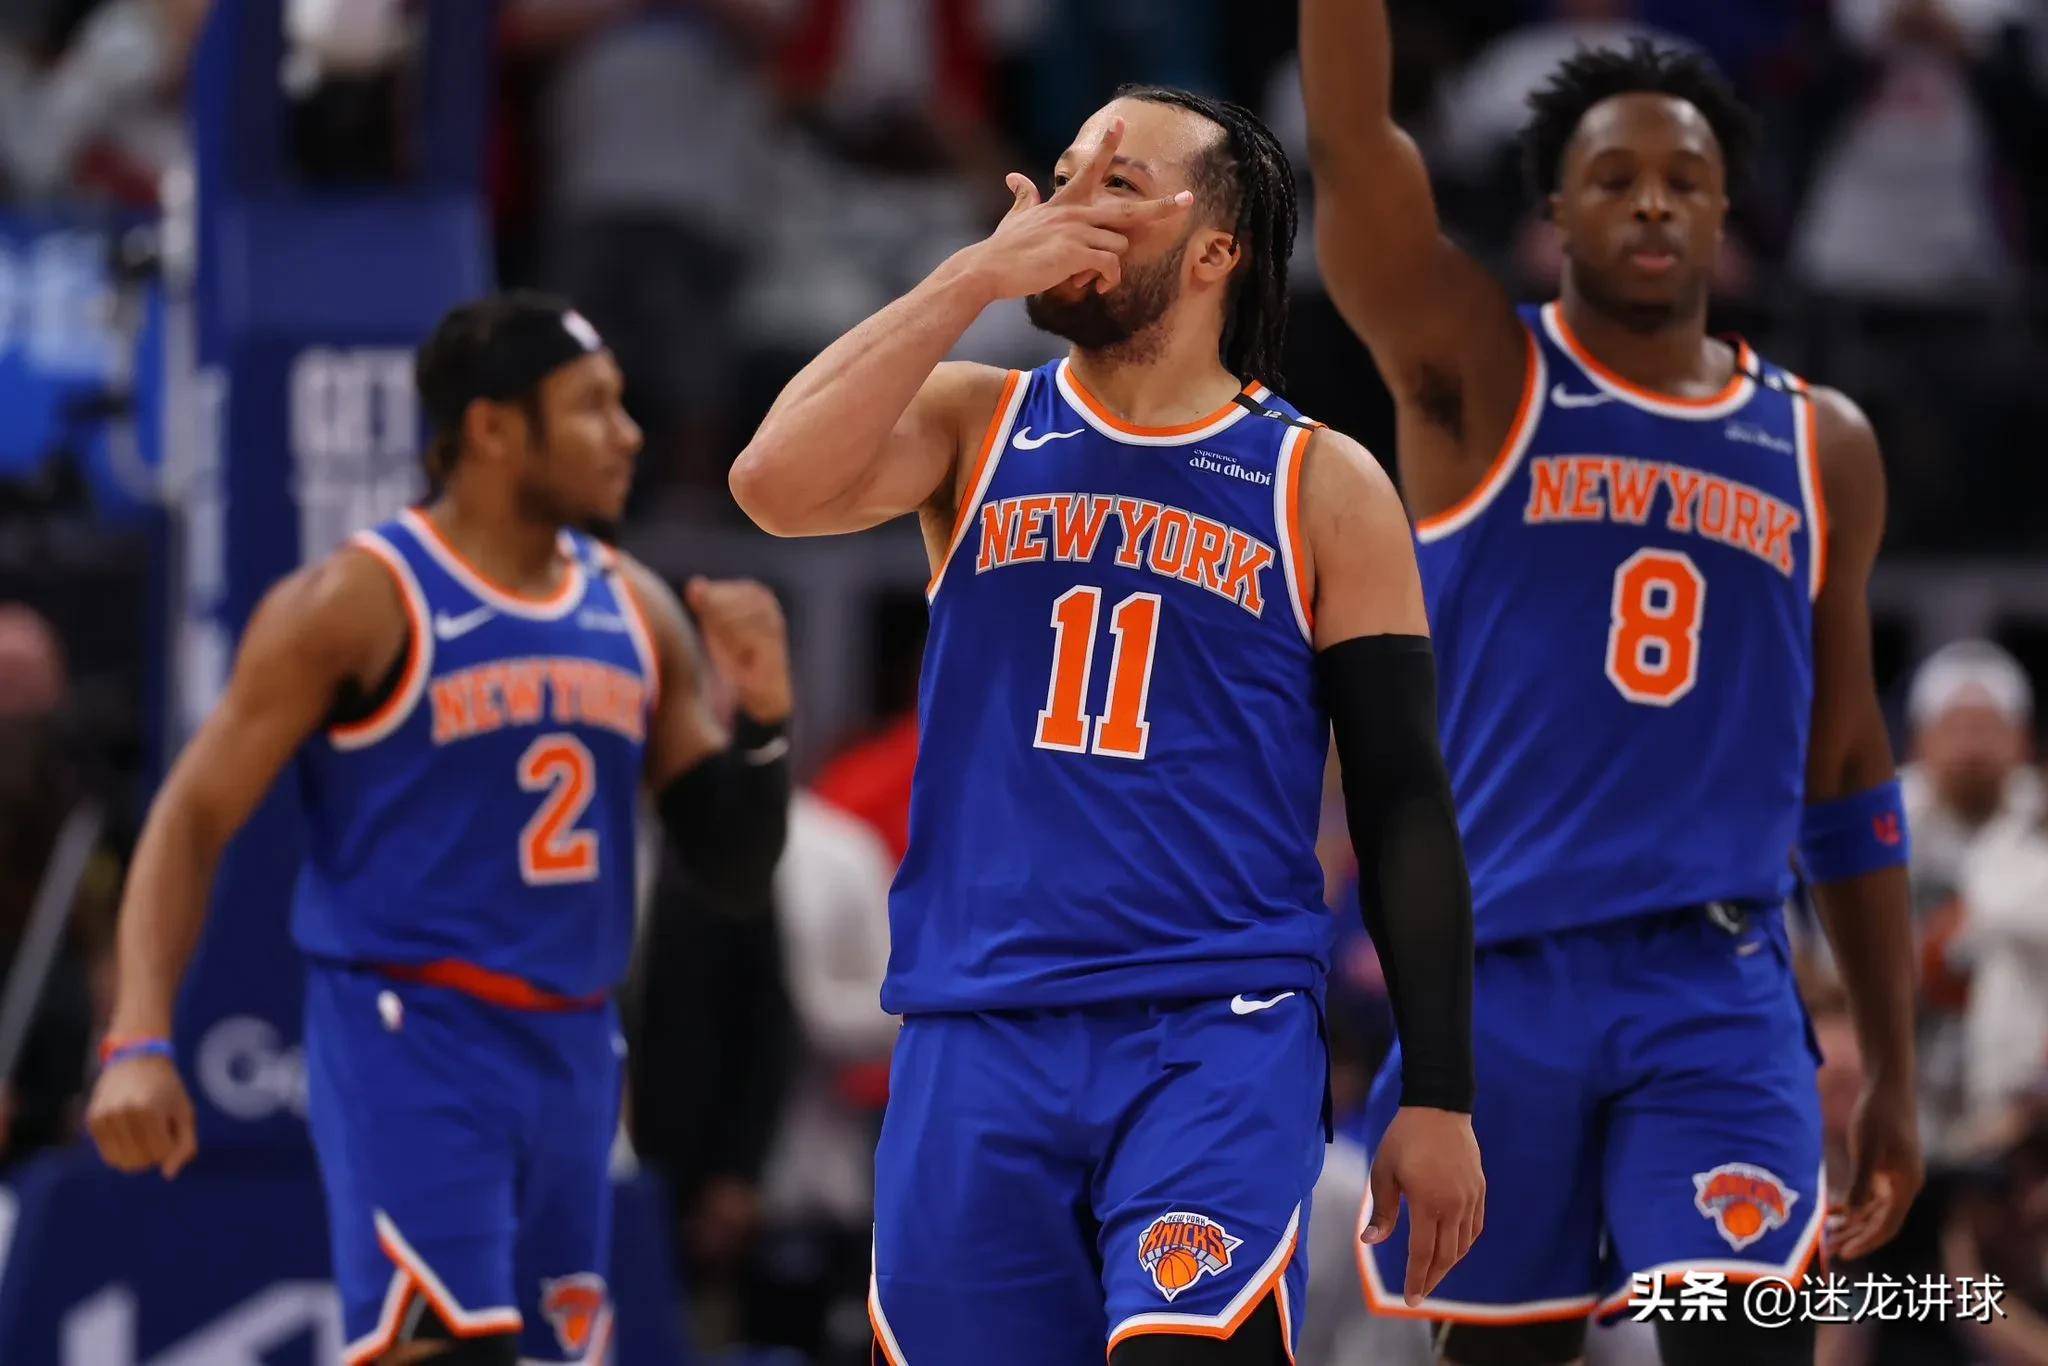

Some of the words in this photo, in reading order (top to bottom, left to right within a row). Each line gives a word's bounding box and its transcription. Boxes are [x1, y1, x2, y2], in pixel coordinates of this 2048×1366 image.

[1189, 456, 1222, 474] abu
[1223, 463, 1272, 486] dhabi
[1193, 448, 1238, 463] experience
[975, 492, 1113, 575] NEW
[1113, 494, 1275, 619] YORK
[1525, 455, 1660, 524] NEW
[1666, 467, 1801, 577] YORK
[1032, 584, 1162, 760] 11
[1605, 547, 1706, 707] 8
[431, 658, 547, 745] NEW
[516, 731, 599, 885] 2
[1140, 1220, 1229, 1266] KNICKS
[1166, 1214, 1185, 1223] NEW
[1186, 1215, 1206, 1226] YORK
